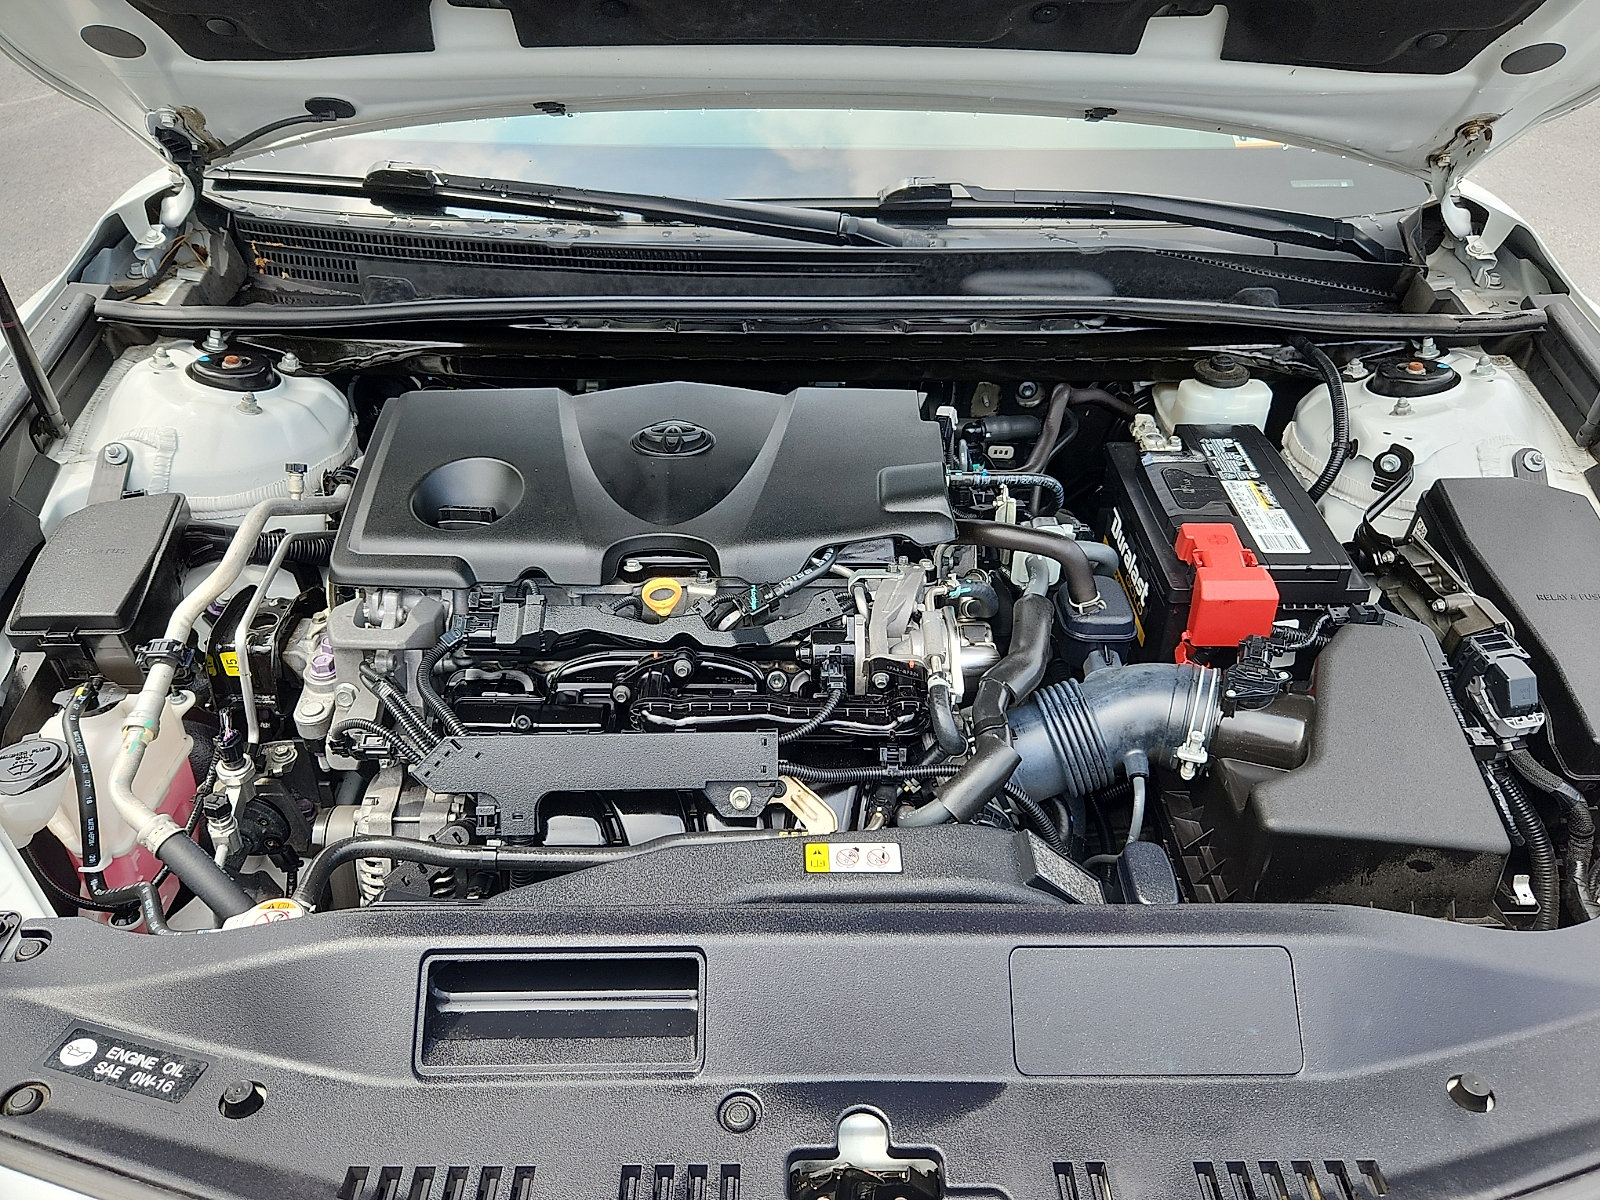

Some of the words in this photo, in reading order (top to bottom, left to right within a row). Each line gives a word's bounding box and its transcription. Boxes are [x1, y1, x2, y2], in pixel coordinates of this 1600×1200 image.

[1111, 507, 1149, 607] Duralast
[1125, 572, 1143, 615] GOLD
[1535, 593, 1568, 601] RELAY
[84, 779, 91, 788] 07
[93, 1061, 126, 1079] SAE
[129, 1071, 175, 1093] 0W-16
[105, 1046, 159, 1069] ENGINE
[162, 1062, 185, 1078] OIL
